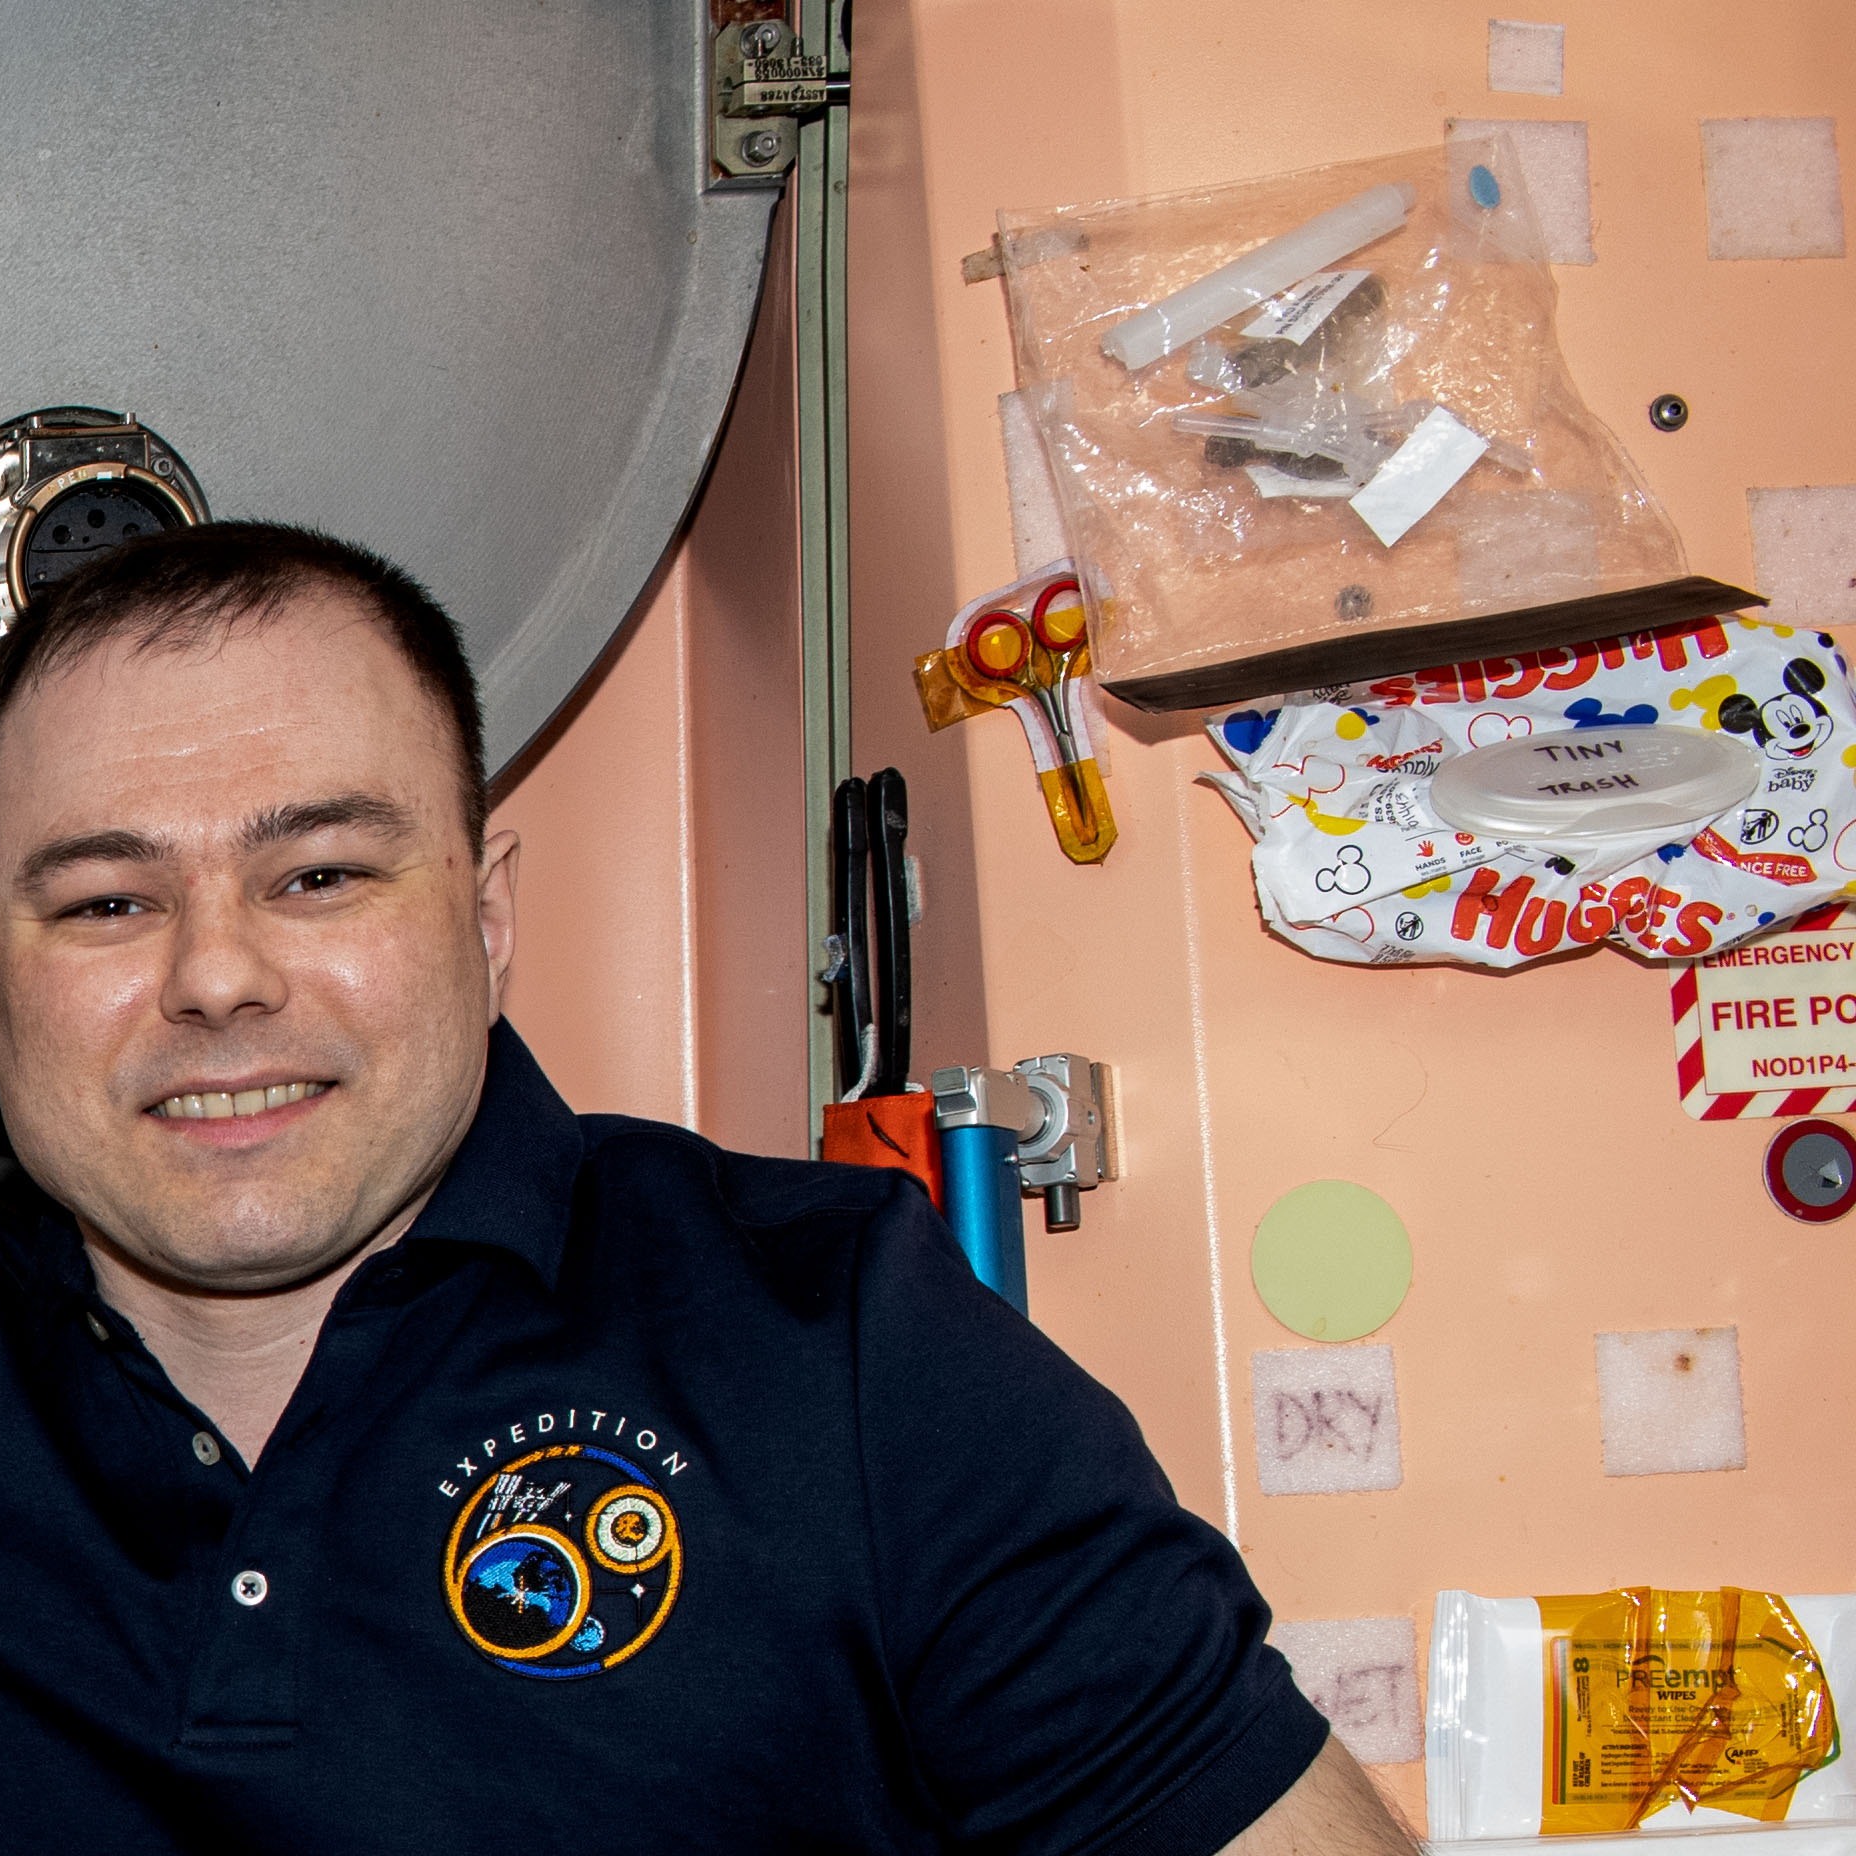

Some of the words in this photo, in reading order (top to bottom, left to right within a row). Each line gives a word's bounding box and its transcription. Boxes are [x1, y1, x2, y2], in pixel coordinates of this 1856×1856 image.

[1534, 741, 1621, 762] TINY
[1538, 774, 1640, 796] TRASH
[1768, 774, 1816, 792] baby
[1415, 857, 1446, 871] HANDS
[1459, 846, 1482, 857] FACE
[1775, 864, 1807, 877] FREE
[1702, 942, 1854, 968] EMERGENCY
[1712, 998, 1797, 1031] FIRE
[438, 1408, 688, 1499] EXPEDITION
[1616, 1668, 1737, 1693] PREempt
[1657, 1691, 1696, 1700] WIPES
[1731, 1749, 1759, 1758] AHP
